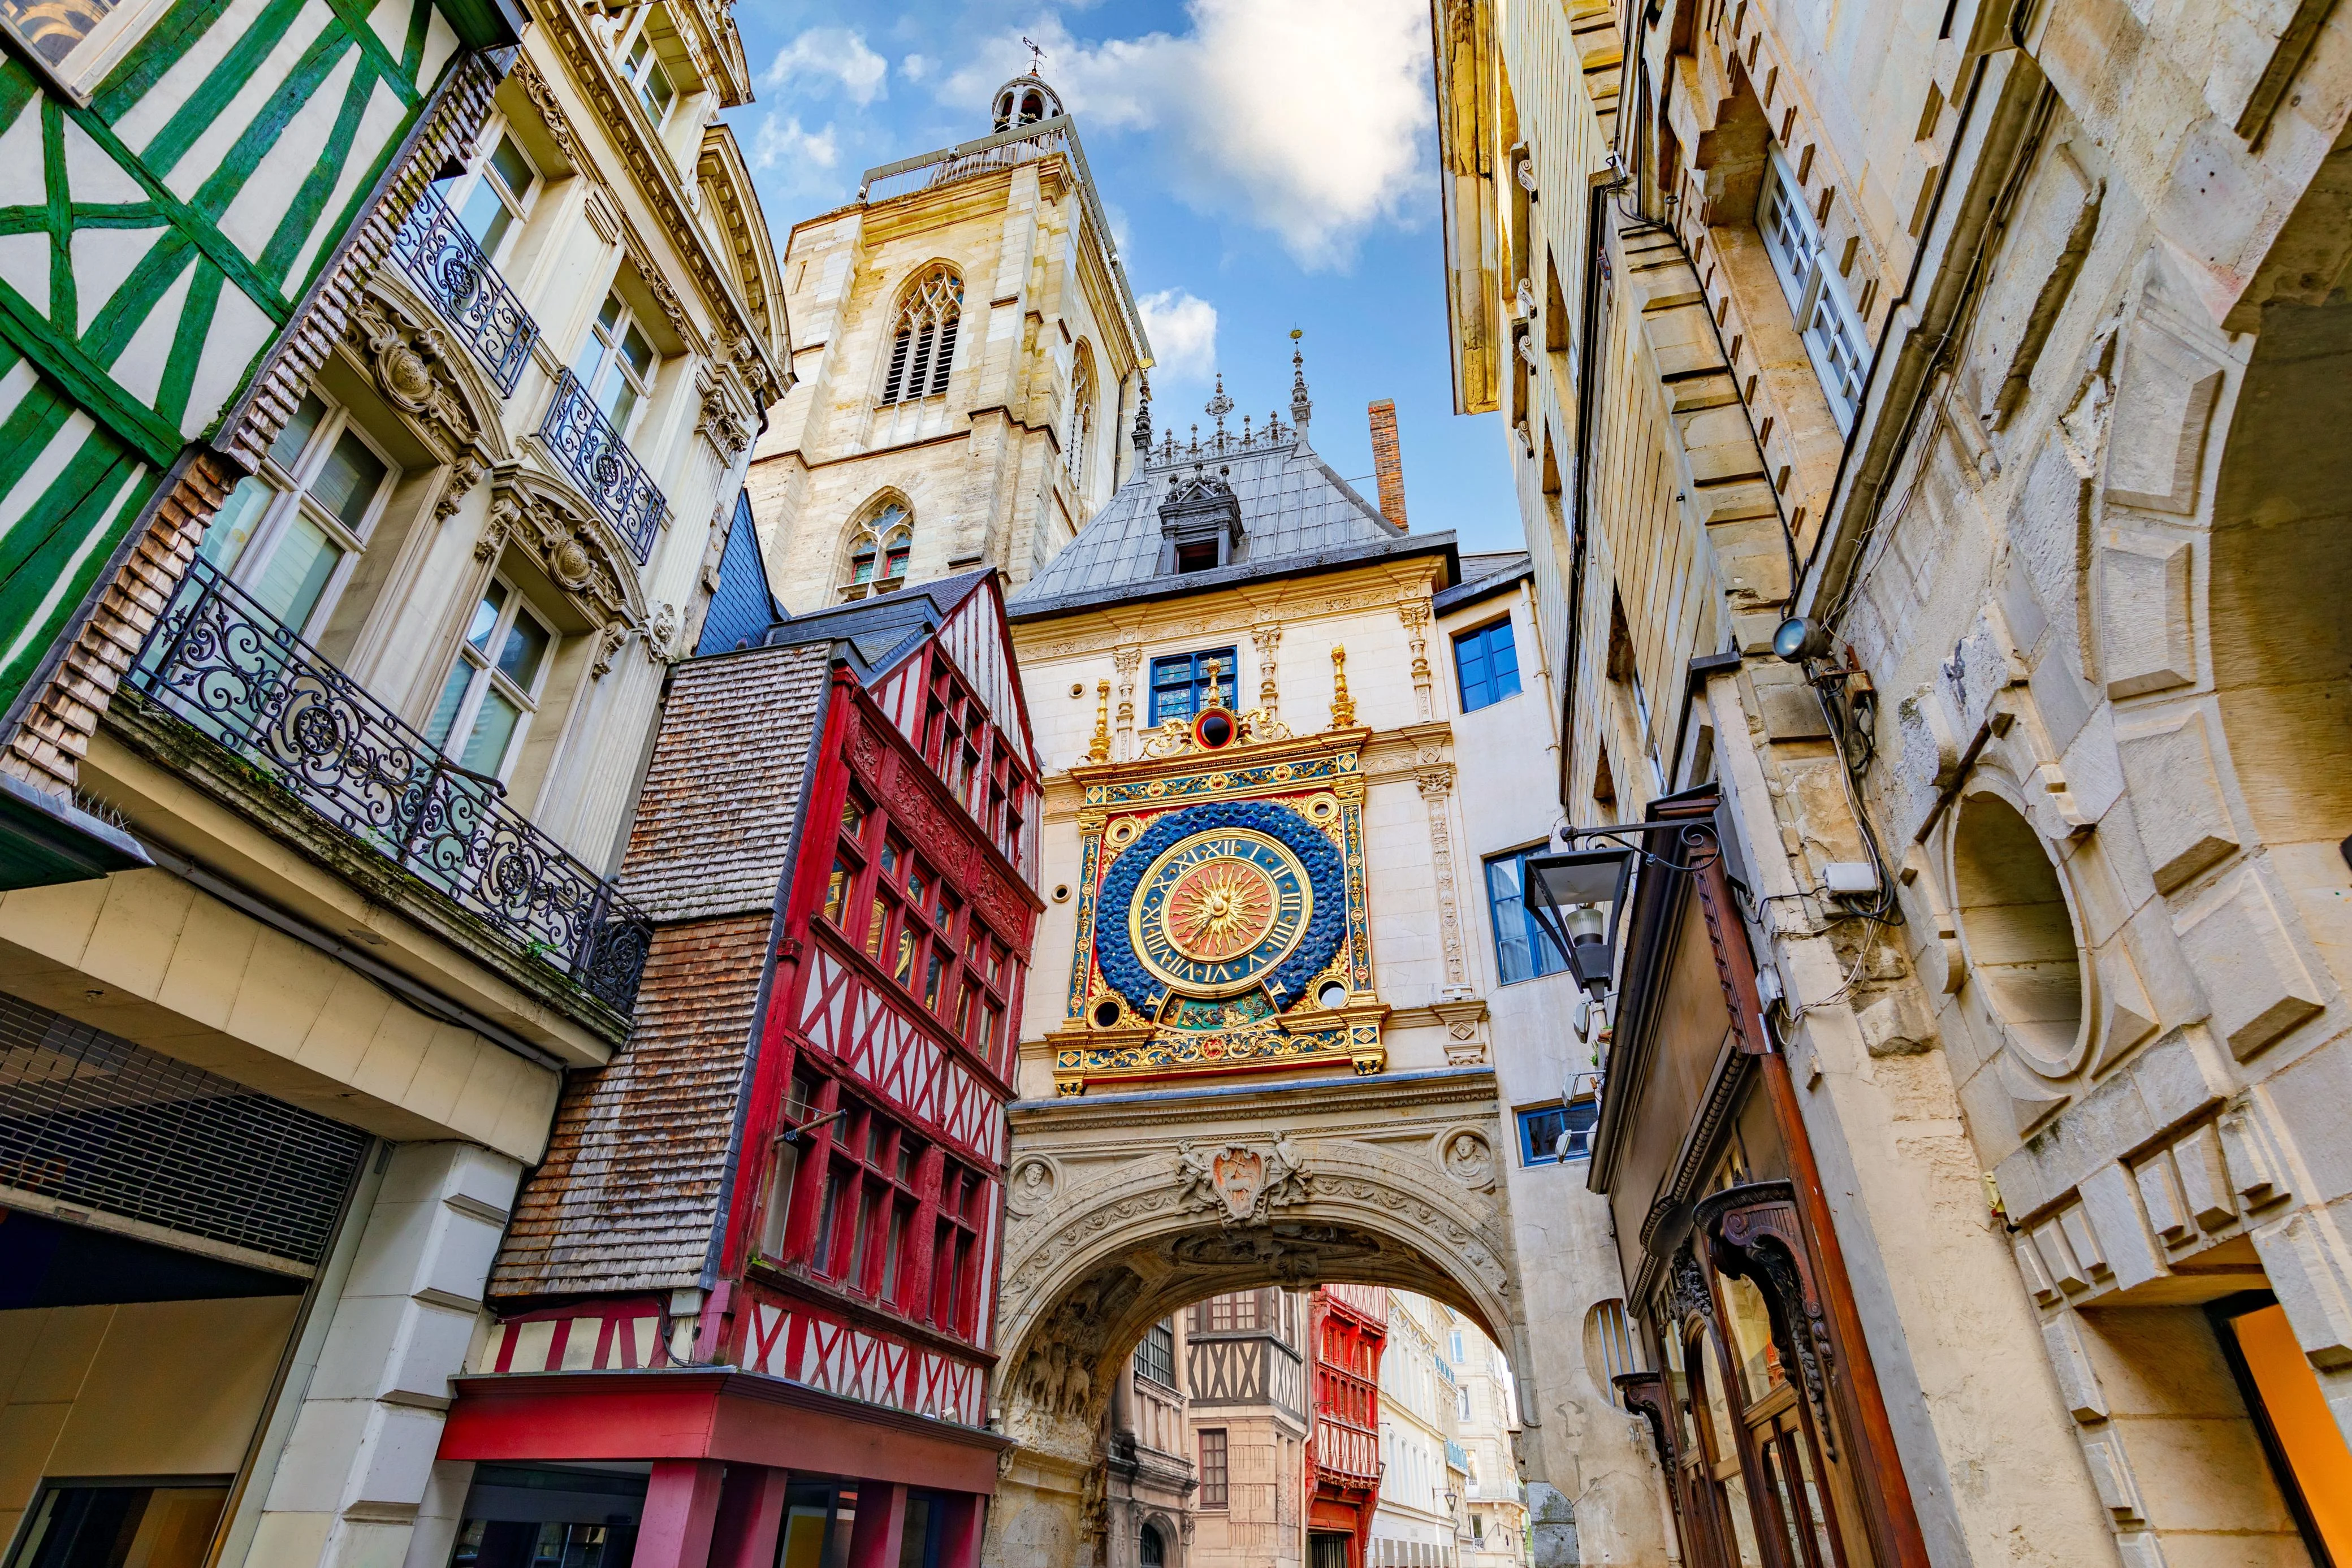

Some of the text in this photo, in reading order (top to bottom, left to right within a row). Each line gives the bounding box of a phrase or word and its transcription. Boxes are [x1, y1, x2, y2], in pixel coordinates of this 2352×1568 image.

[1204, 840, 1236, 859] XII
[1248, 844, 1261, 860] I
[1171, 848, 1200, 874] XI
[1270, 863, 1292, 880] II
[1150, 874, 1175, 894] X
[1281, 892, 1300, 911] III
[1143, 905, 1161, 929] IX
[1266, 920, 1295, 950] IIII
[1144, 930, 1171, 966] VIII
[1166, 955, 1195, 982] VII
[1249, 954, 1268, 973] V
[1204, 964, 1232, 983] VI
